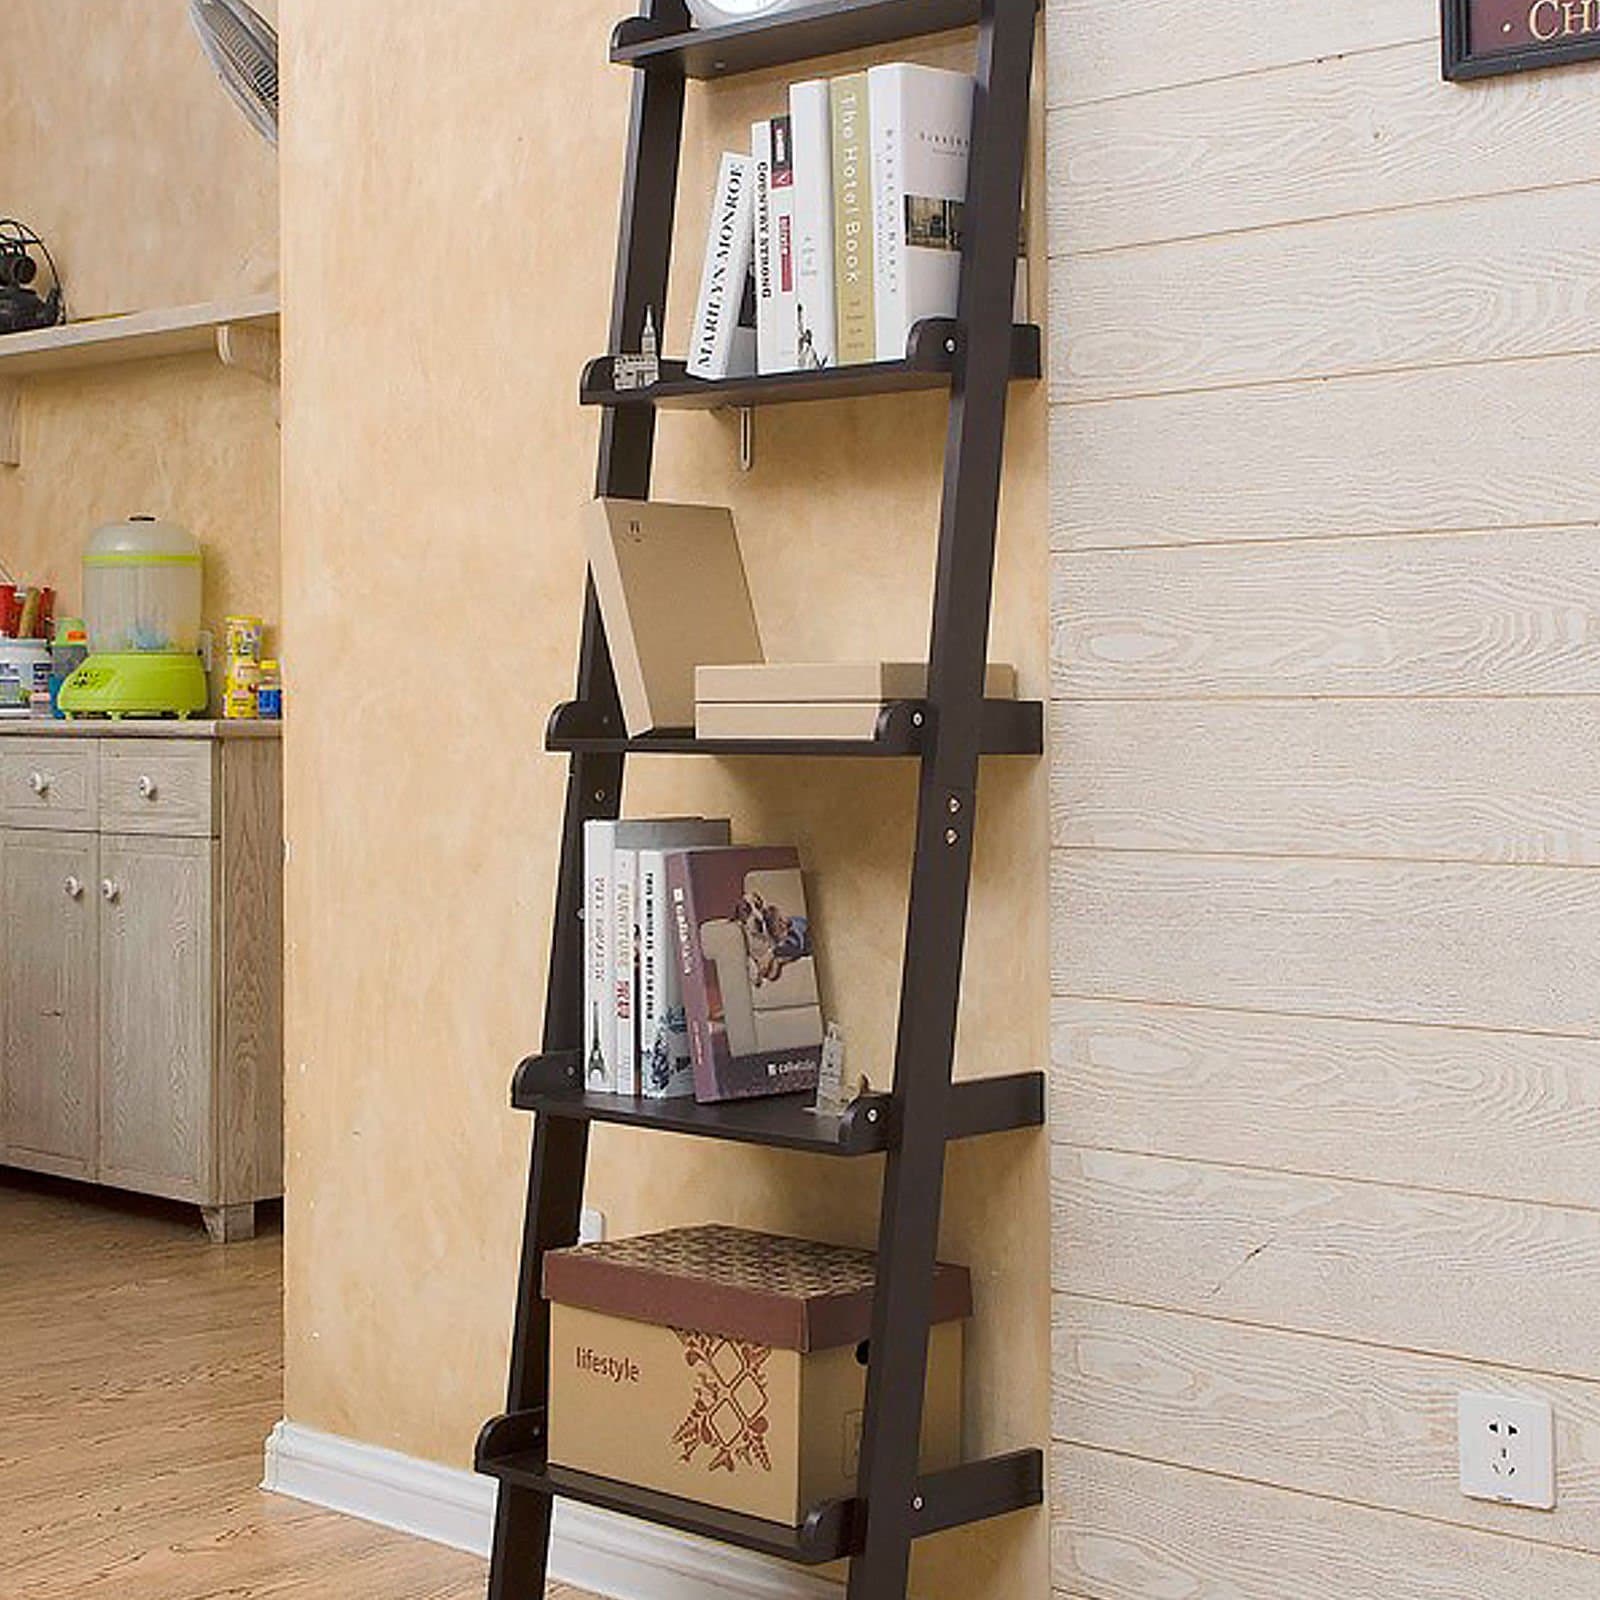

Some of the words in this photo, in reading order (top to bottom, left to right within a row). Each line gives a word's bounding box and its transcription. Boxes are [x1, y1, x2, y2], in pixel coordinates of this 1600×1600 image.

[1529, 0, 1600, 41] CH
[840, 94, 857, 140] The
[757, 161, 769, 235] COUNTRY
[842, 146, 859, 214] Hotel
[697, 266, 725, 368] MARILYN
[716, 163, 744, 262] MONROE
[760, 238, 772, 299] STRONG
[844, 221, 861, 285] Book
[576, 1346, 640, 1384] lifestyle
